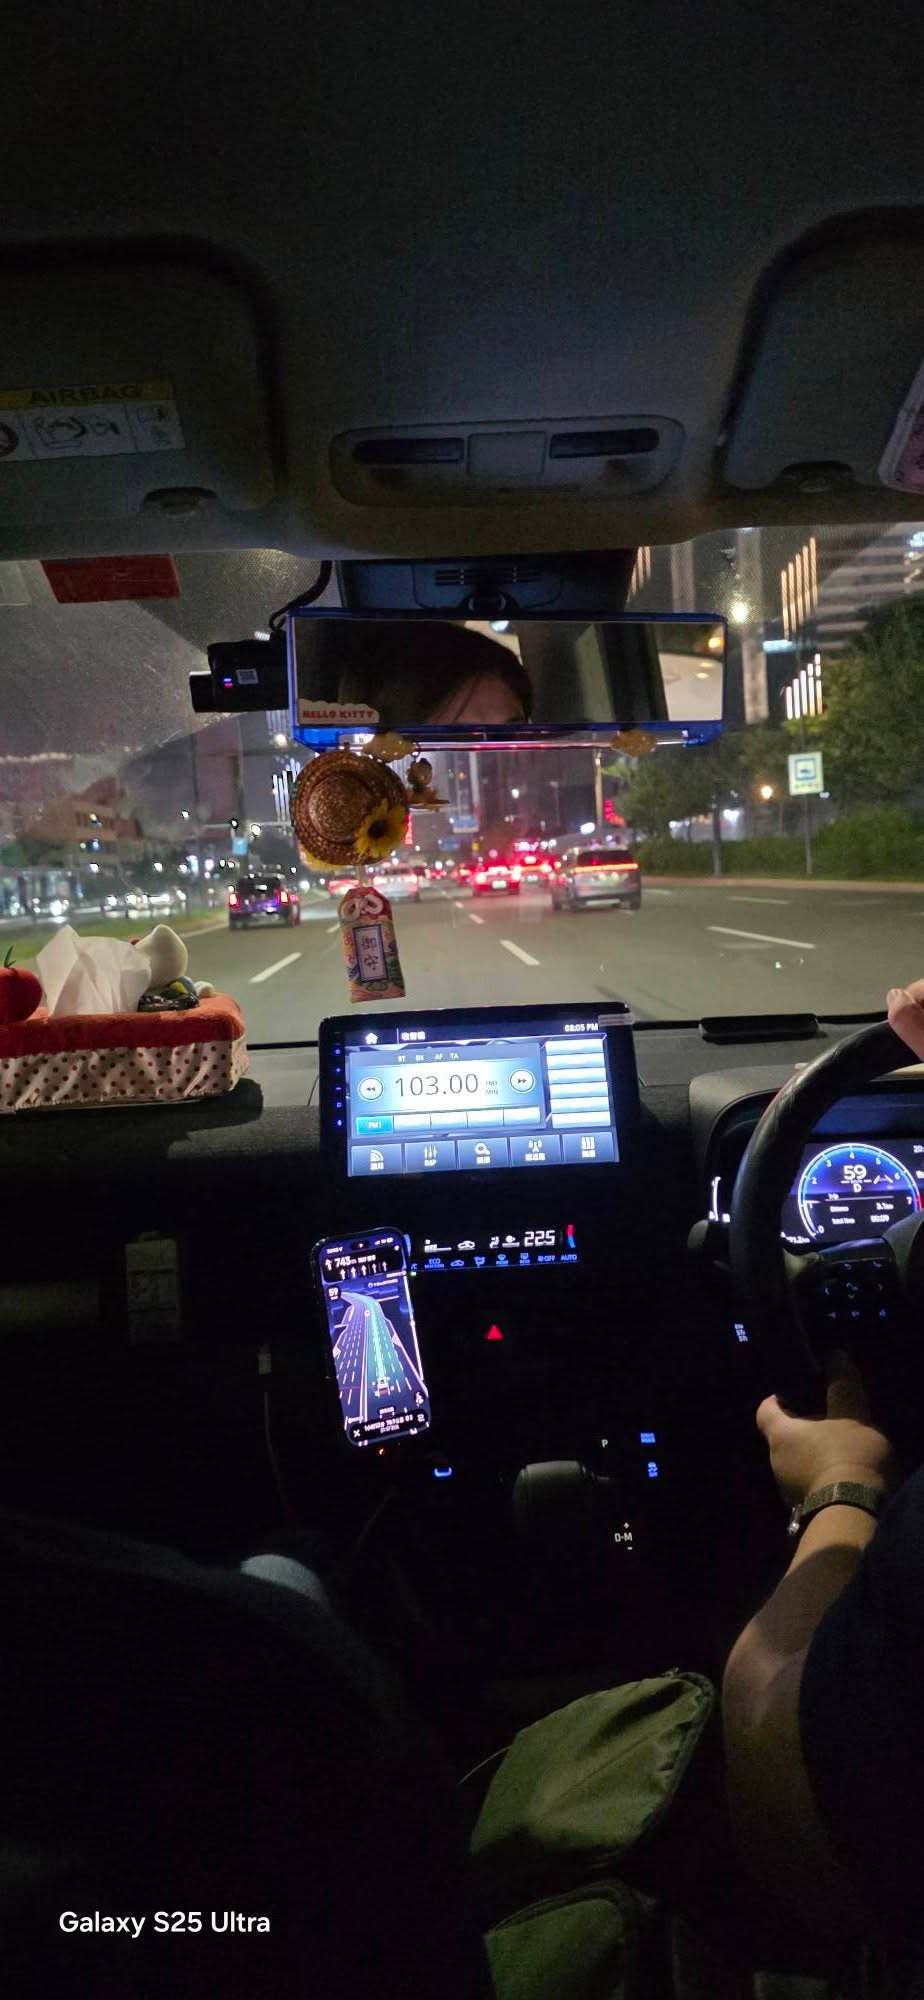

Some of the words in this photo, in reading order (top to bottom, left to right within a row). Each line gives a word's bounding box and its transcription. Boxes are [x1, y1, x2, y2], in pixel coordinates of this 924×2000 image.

[32, 385, 140, 403] AIRBAG
[303, 710, 336, 719] HELLO
[340, 710, 374, 719] KITTY
[587, 1022, 599, 1031] PM
[395, 1073, 479, 1097] 103.00
[842, 1164, 867, 1180] 59
[853, 1183, 862, 1193] D
[601, 1438, 609, 1448] P
